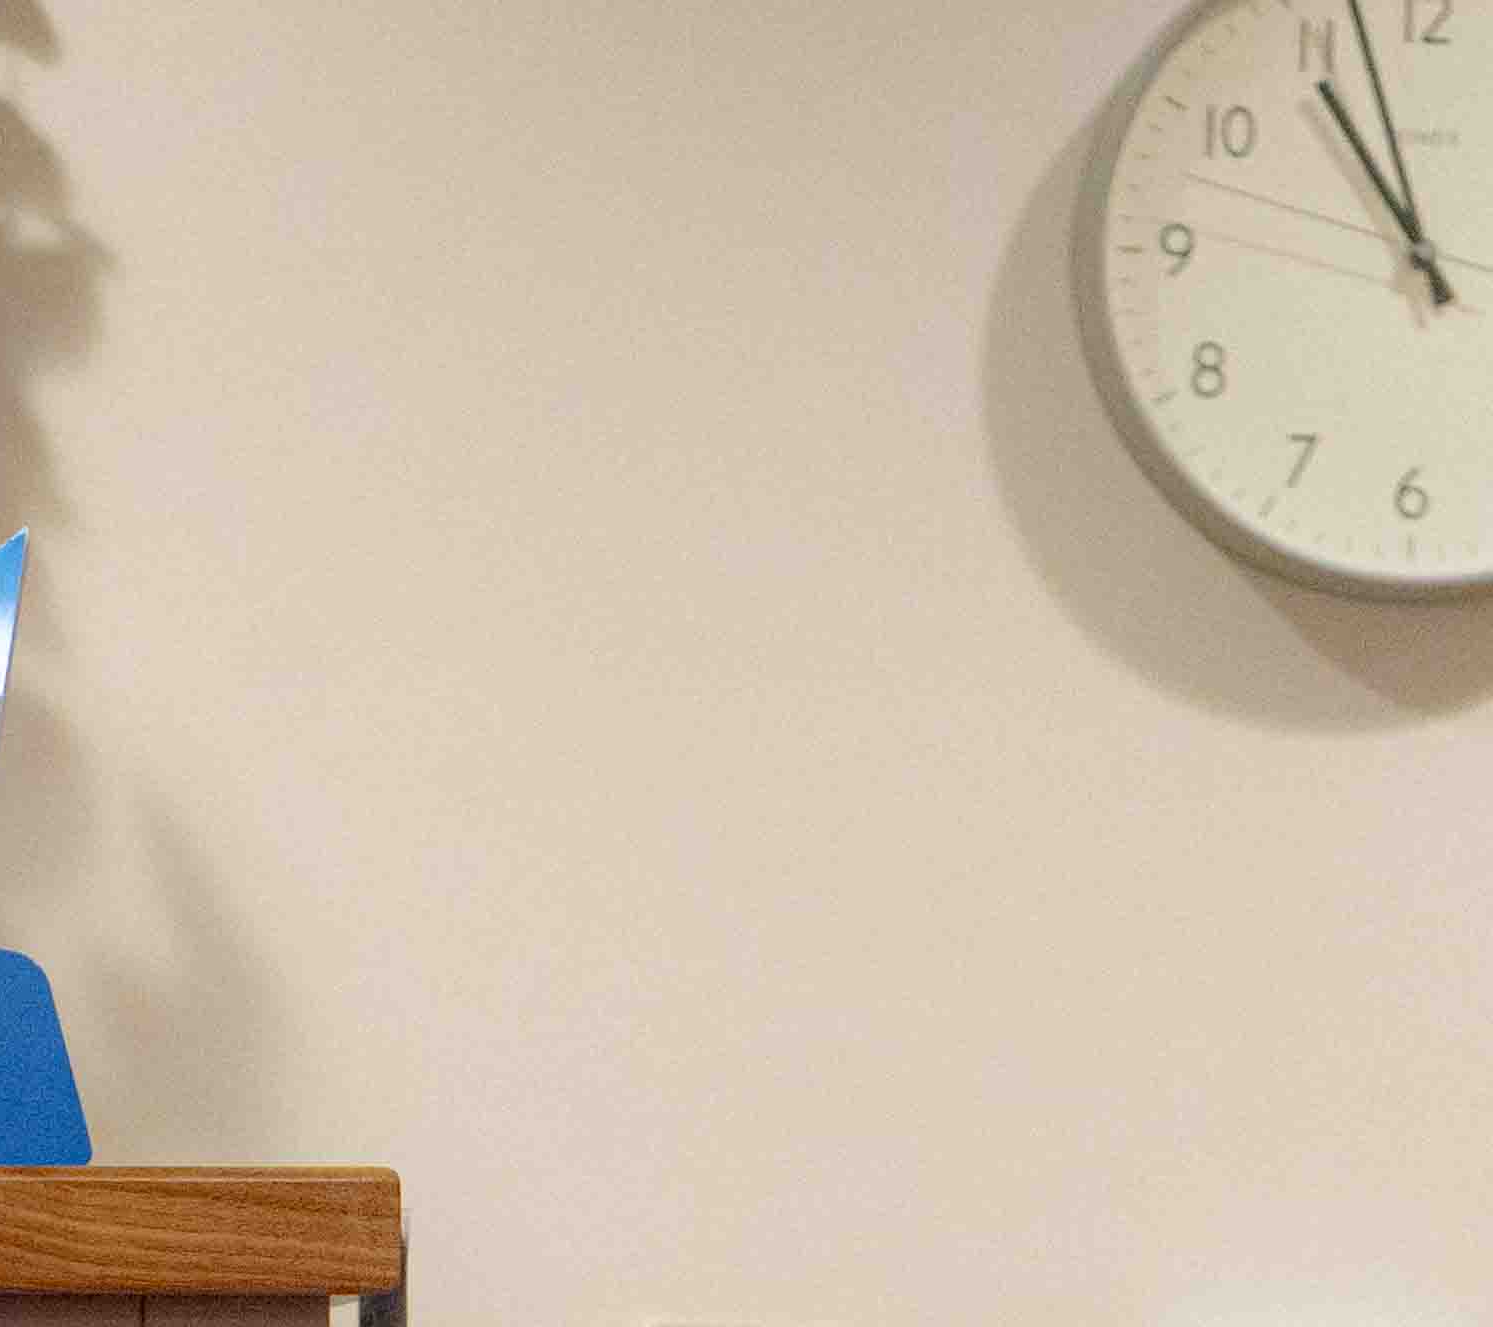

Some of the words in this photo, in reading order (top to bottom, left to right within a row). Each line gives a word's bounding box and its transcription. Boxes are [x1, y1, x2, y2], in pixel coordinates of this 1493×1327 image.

[1298, 20, 1334, 73] 11
[1403, 0, 1452, 44] 12
[1202, 103, 1256, 160] 10
[1159, 223, 1195, 277] 9
[1191, 341, 1226, 399] 8
[1287, 433, 1319, 488] 7
[1395, 466, 1429, 521] 6
